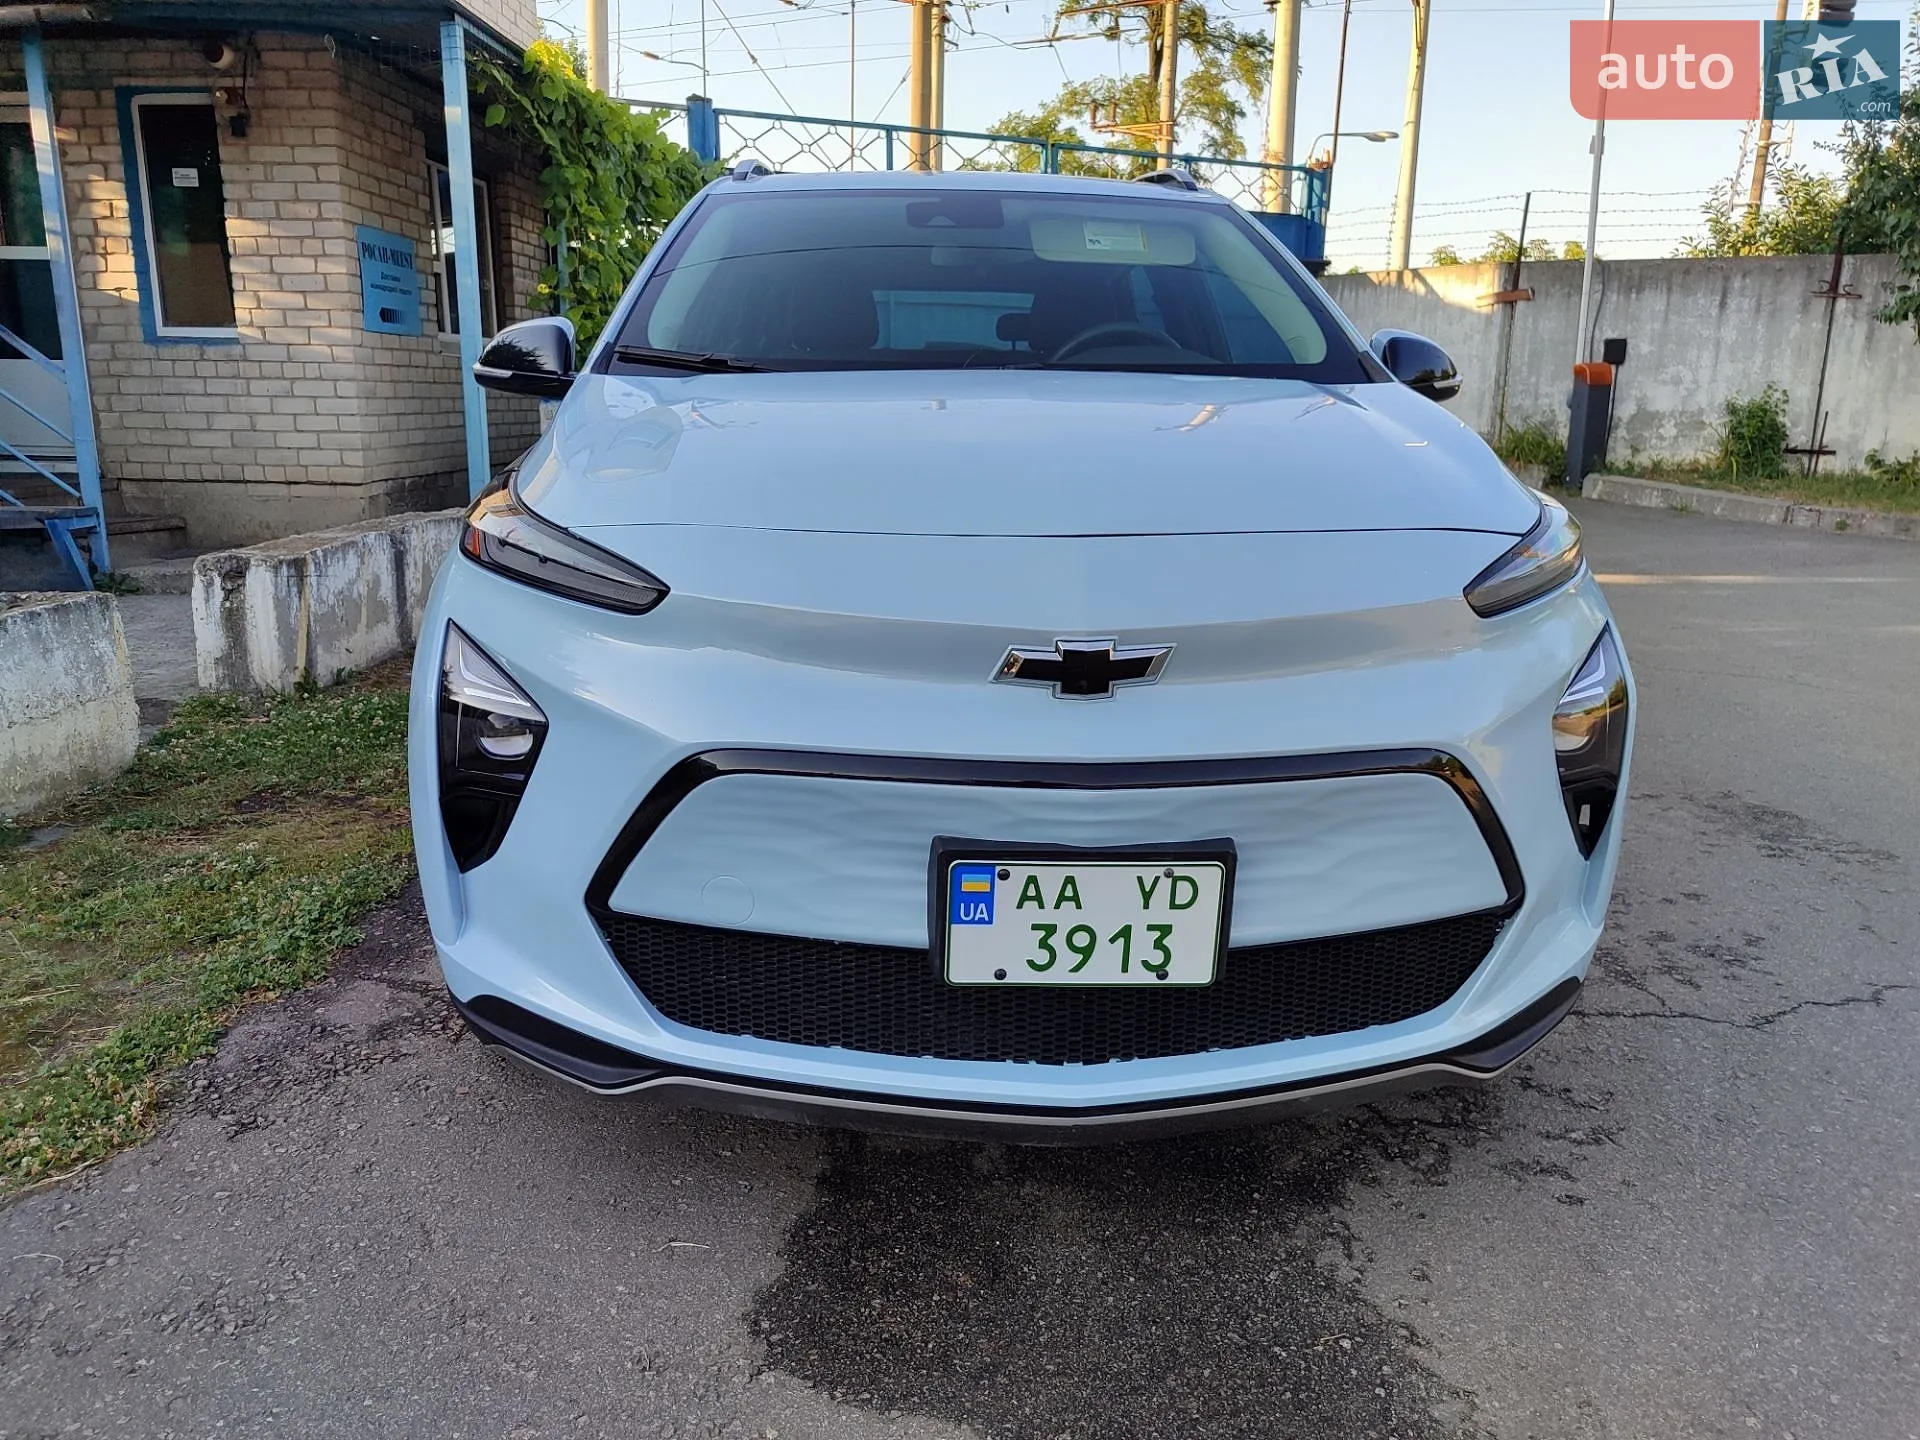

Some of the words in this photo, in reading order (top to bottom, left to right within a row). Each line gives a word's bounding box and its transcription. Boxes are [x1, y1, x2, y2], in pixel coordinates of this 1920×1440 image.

[1016, 875, 1083, 910] AA
[1136, 875, 1199, 910] YD
[960, 902, 990, 922] UA
[1025, 923, 1174, 974] 3913
